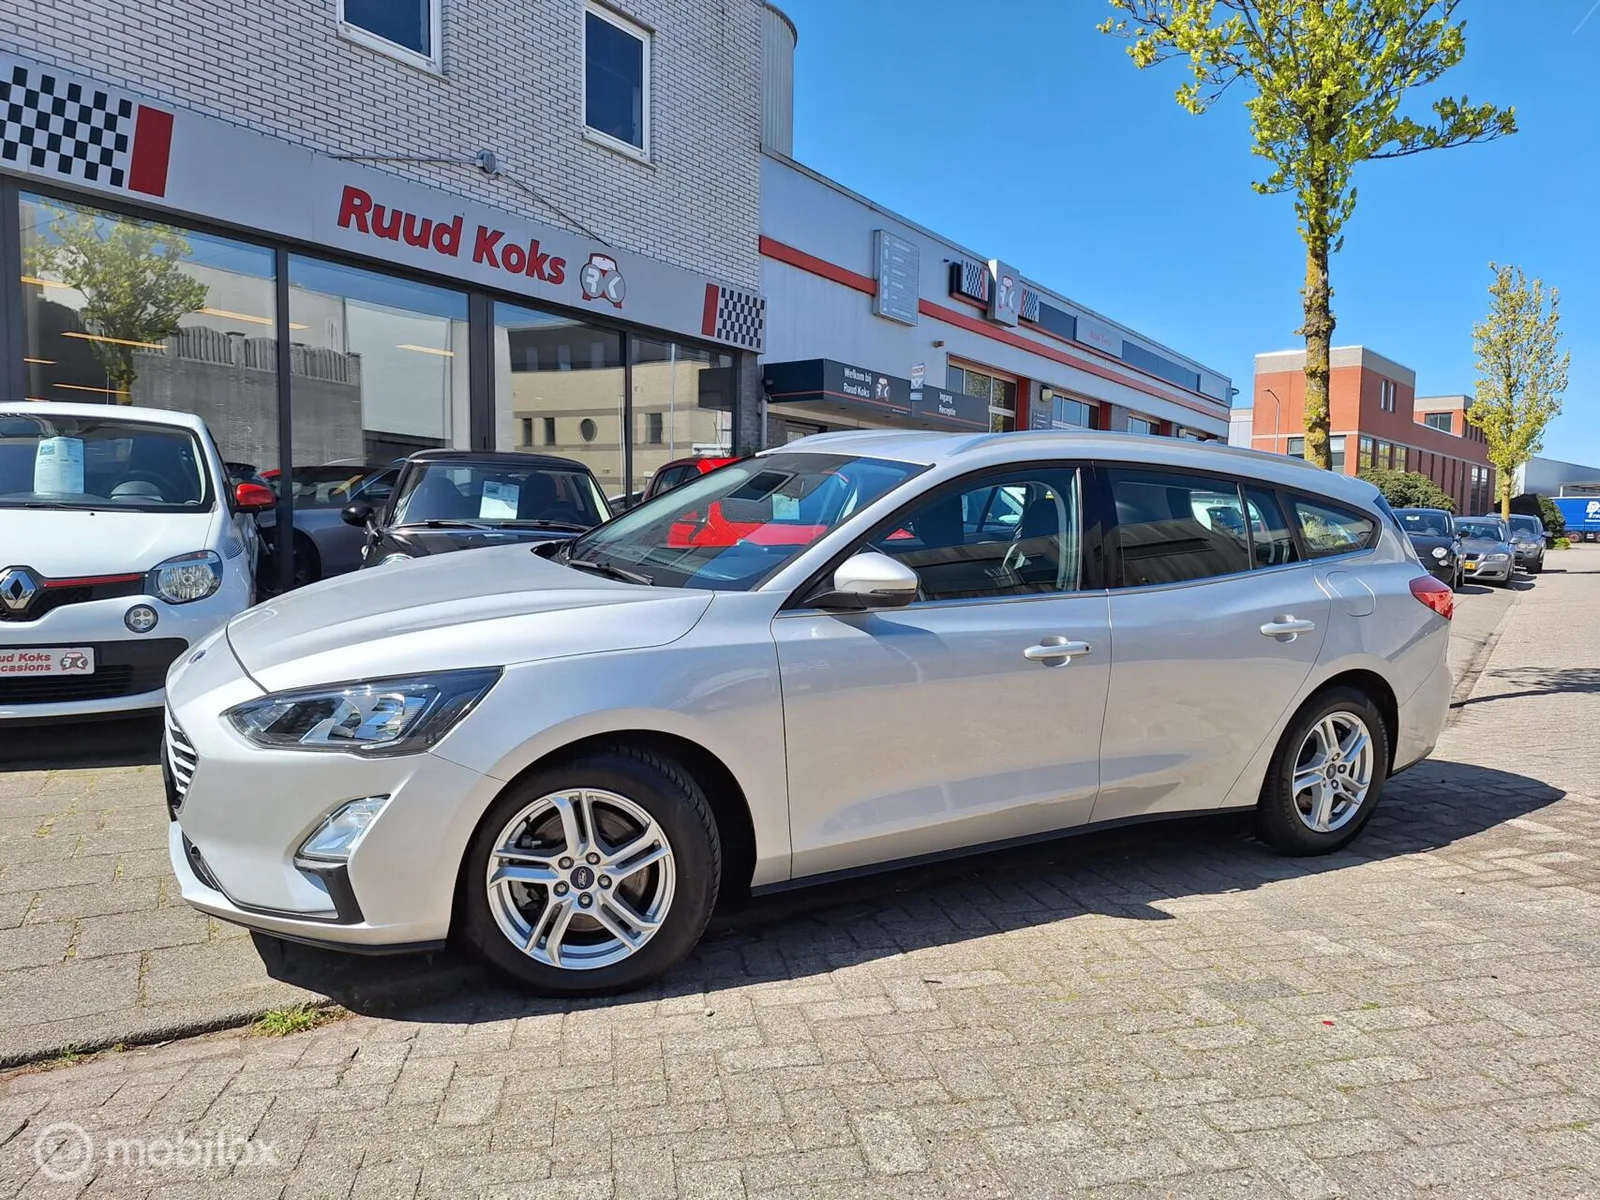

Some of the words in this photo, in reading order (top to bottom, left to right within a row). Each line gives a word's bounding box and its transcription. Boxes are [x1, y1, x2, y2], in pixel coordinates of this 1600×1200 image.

[337, 184, 464, 257] Ruud
[472, 225, 567, 285] Koks
[844, 367, 865, 382] Welkom
[843, 382, 857, 394] Ruud
[857, 386, 870, 397] Koks
[18, 652, 51, 662] Koks
